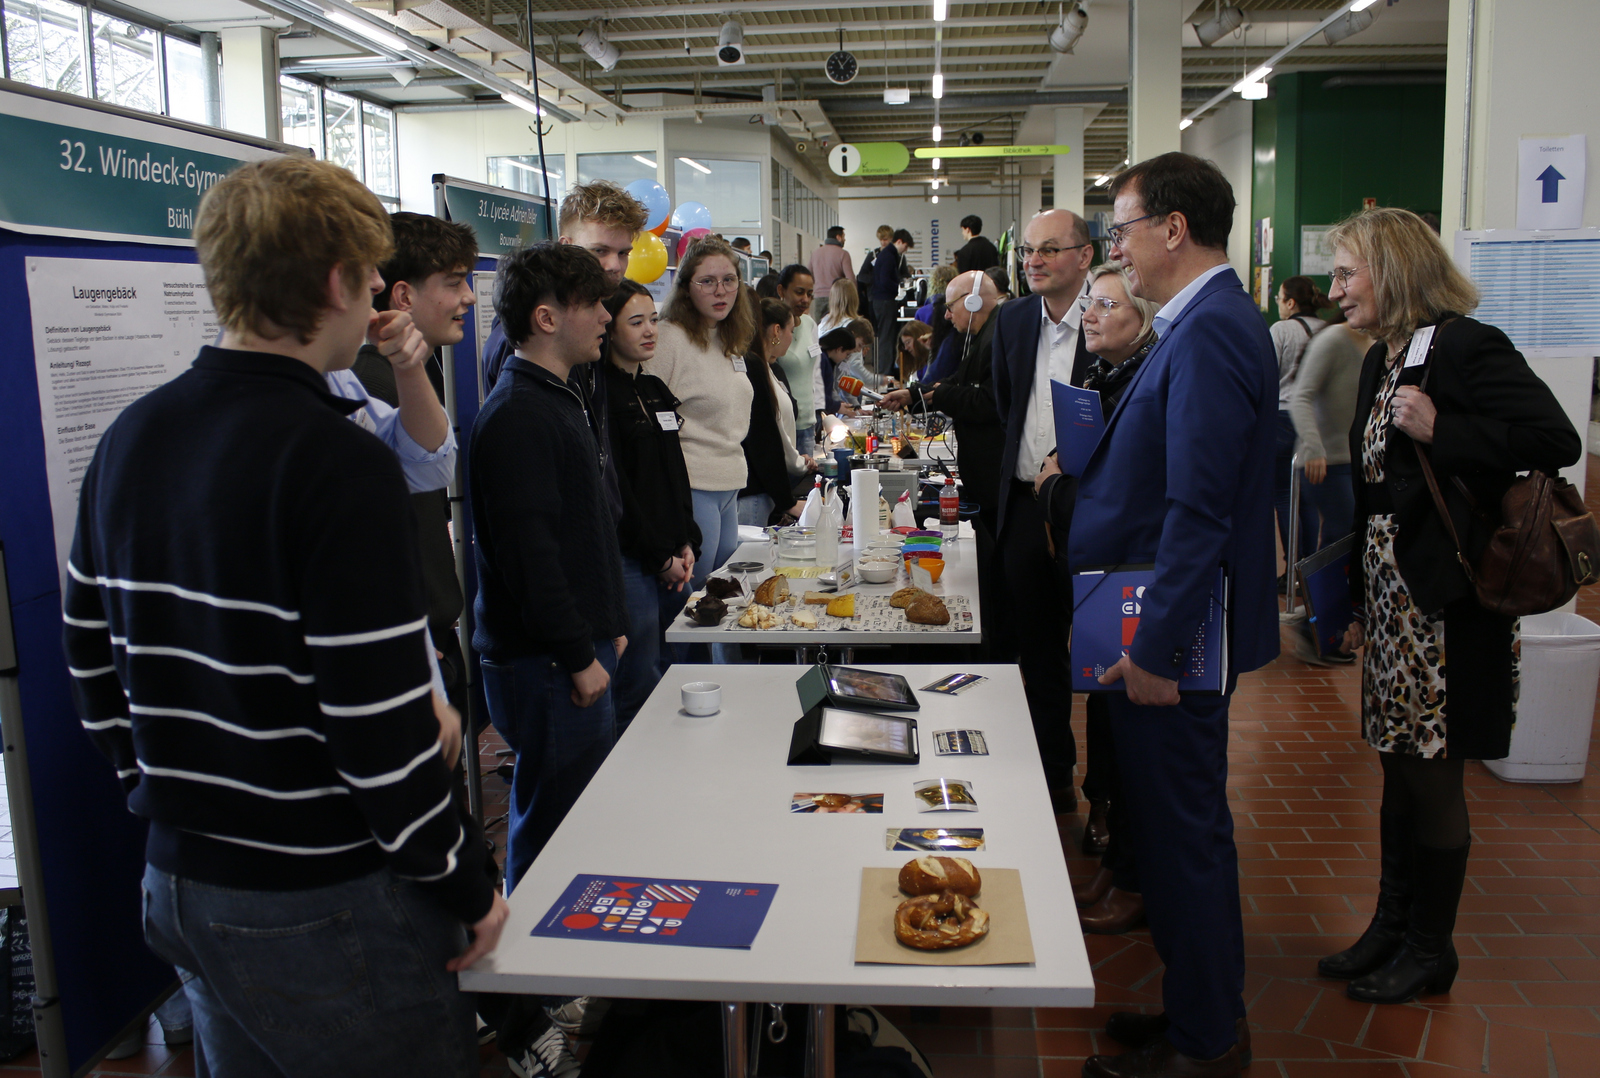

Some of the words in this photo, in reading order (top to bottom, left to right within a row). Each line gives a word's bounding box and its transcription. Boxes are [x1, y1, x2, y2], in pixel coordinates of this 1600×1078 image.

[60, 139, 92, 173] 32.
[168, 207, 192, 230] Bühl
[478, 200, 488, 217] 31.
[490, 202, 509, 222] Lycée
[510, 205, 527, 222] Adrien
[72, 286, 137, 302] Laugengebäck
[45, 326, 69, 334] Definition
[80, 324, 112, 333] Laugengebäck
[76, 359, 91, 368] Rezept
[57, 424, 76, 435] Einfluss
[84, 422, 96, 430] Base
